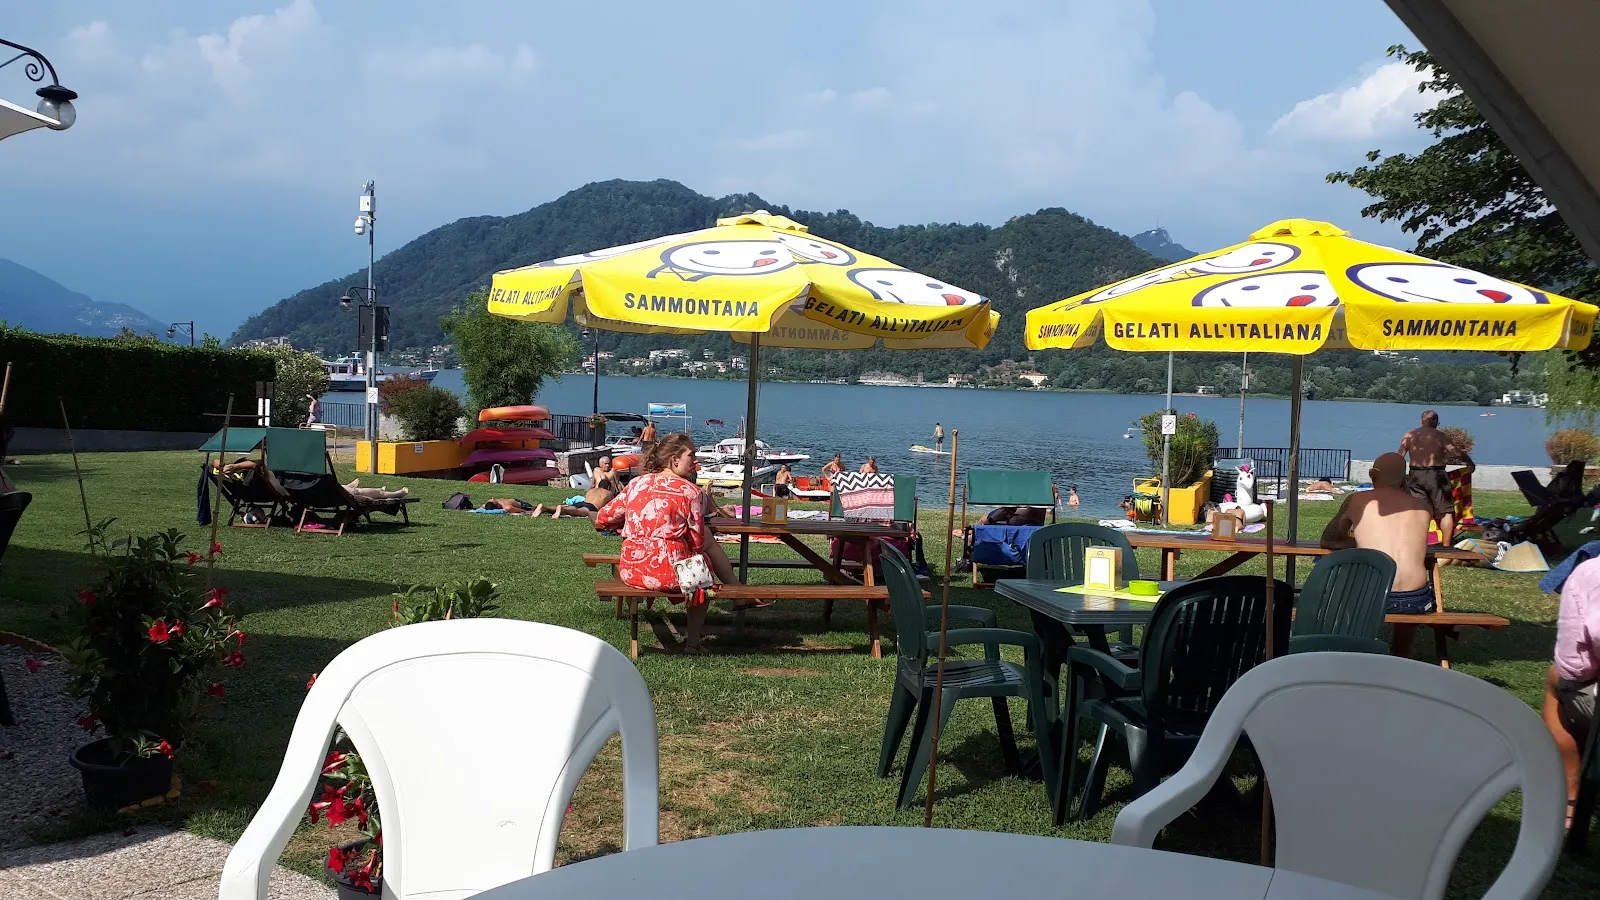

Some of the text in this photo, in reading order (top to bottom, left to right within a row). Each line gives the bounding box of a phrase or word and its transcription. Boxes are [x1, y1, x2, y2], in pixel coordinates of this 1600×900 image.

[624, 292, 759, 317] SAMMONTANA
[804, 296, 866, 326] GELATI
[1114, 322, 1179, 339] GELATI
[1189, 323, 1322, 341] ALL'ITALIANA
[1382, 319, 1517, 337] SAMMONTANA
